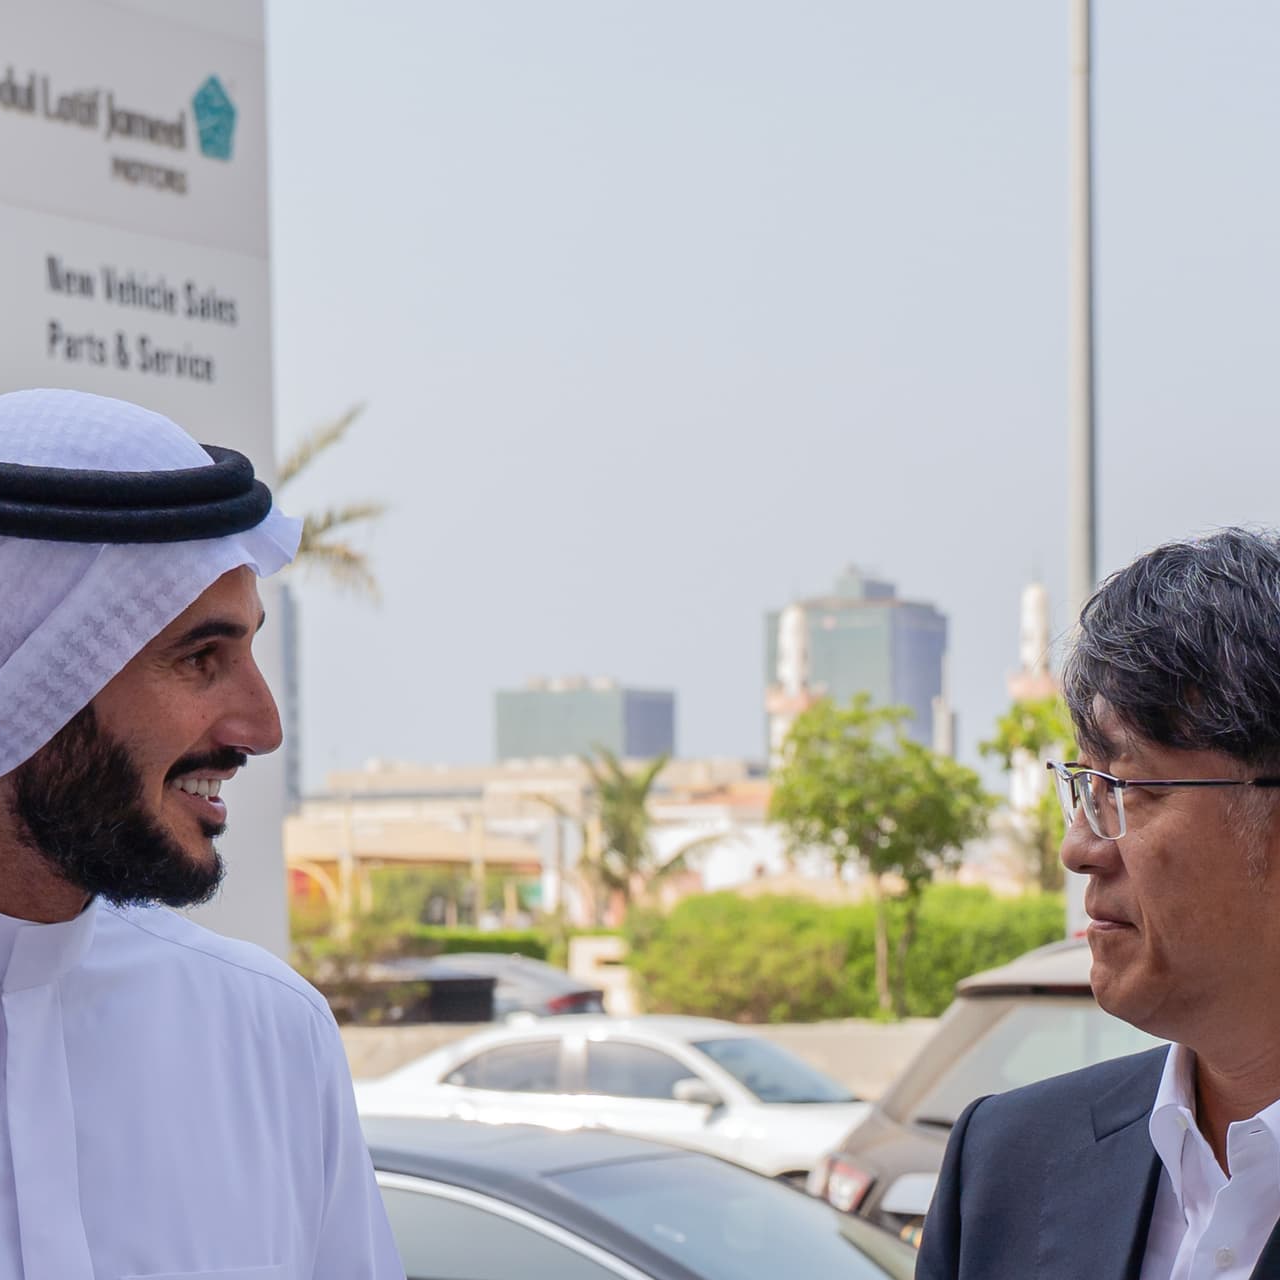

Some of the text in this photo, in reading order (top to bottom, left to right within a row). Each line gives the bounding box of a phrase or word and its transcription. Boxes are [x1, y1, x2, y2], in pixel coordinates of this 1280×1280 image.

[41, 75, 100, 130] Latif
[104, 91, 187, 152] Jameel
[46, 255, 239, 328] New Vehicle Sales
[48, 320, 216, 382] Parts & Service
